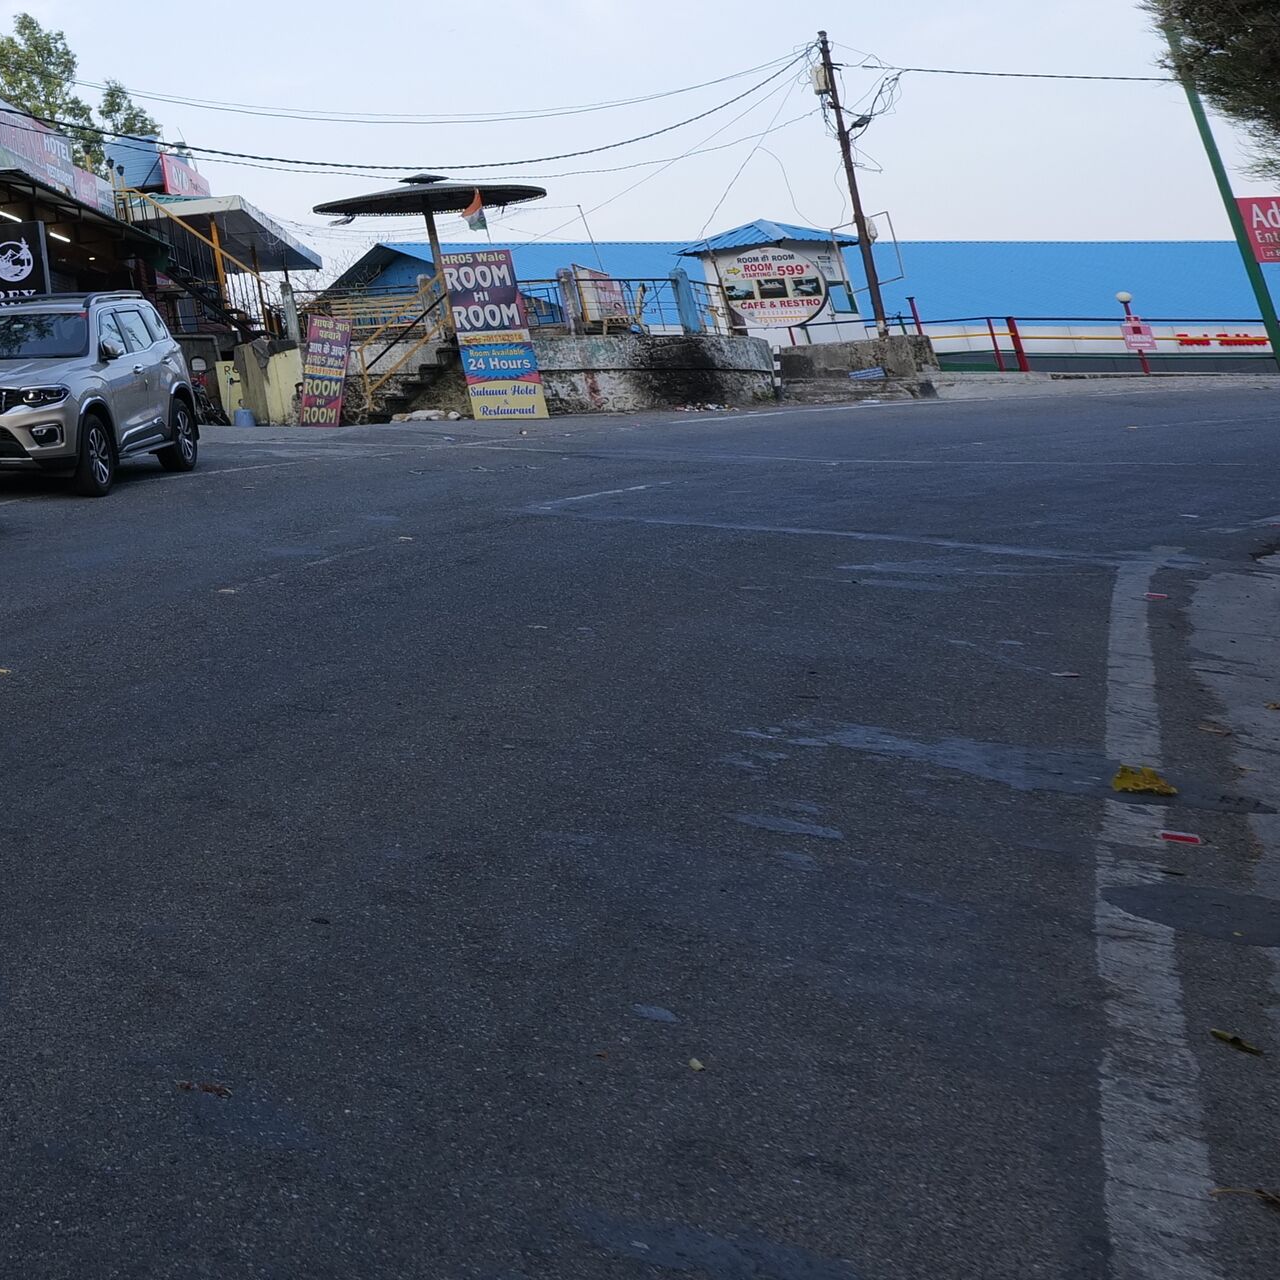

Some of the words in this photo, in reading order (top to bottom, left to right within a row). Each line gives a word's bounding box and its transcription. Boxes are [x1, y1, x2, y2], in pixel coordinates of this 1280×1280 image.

[43, 135, 71, 162] HOTEL
[1251, 200, 1280, 229] Ad
[441, 253, 473, 265] HR05
[476, 251, 506, 263] Wale
[743, 263, 773, 273] ROOM
[443, 264, 512, 291] ROOM
[473, 291, 489, 302] HI
[740, 301, 767, 310] CAFE
[780, 298, 821, 308] RESTRO
[452, 302, 521, 331] ROOM
[469, 349, 490, 358] Room
[491, 348, 525, 357] Available
[468, 357, 485, 371] 24
[489, 357, 531, 370] Hours
[304, 379, 341, 397] ROOM
[470, 386, 507, 397] Suhana
[510, 384, 537, 395] Hotel
[303, 407, 336, 424] ROOM
[479, 404, 536, 416] Restaurant
